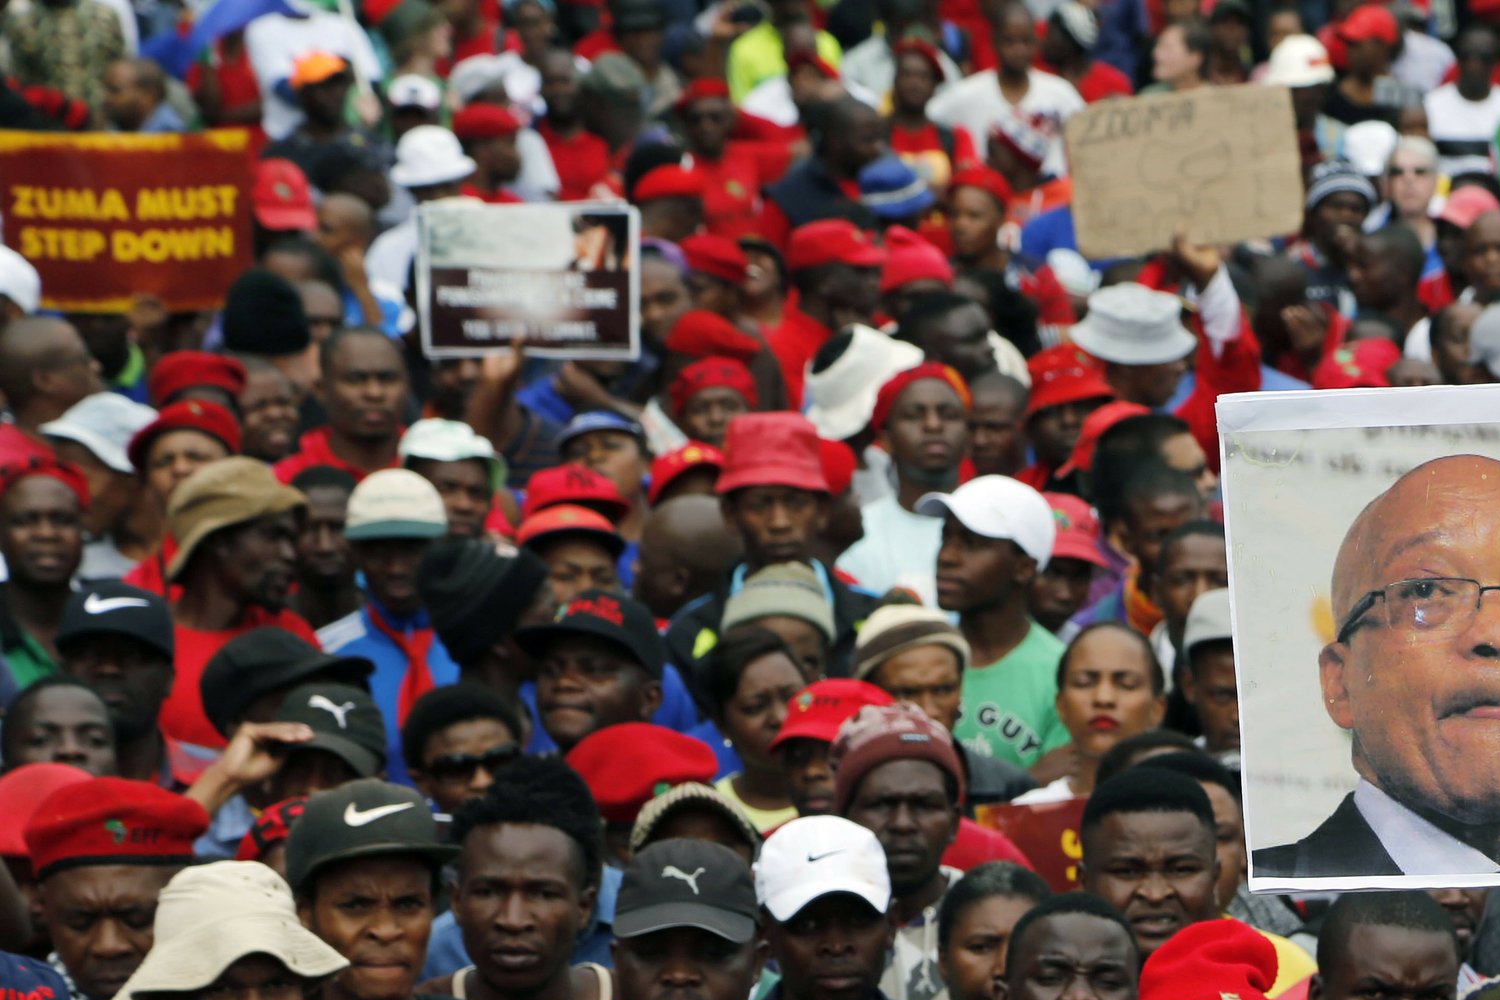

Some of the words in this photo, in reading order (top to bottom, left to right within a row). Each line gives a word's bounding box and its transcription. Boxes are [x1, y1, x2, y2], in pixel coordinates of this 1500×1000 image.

[11, 184, 128, 221] ZUMA
[137, 184, 238, 220] MUST
[20, 226, 106, 261] STEP
[111, 225, 234, 263] DOWN
[980, 707, 1041, 752] GUY
